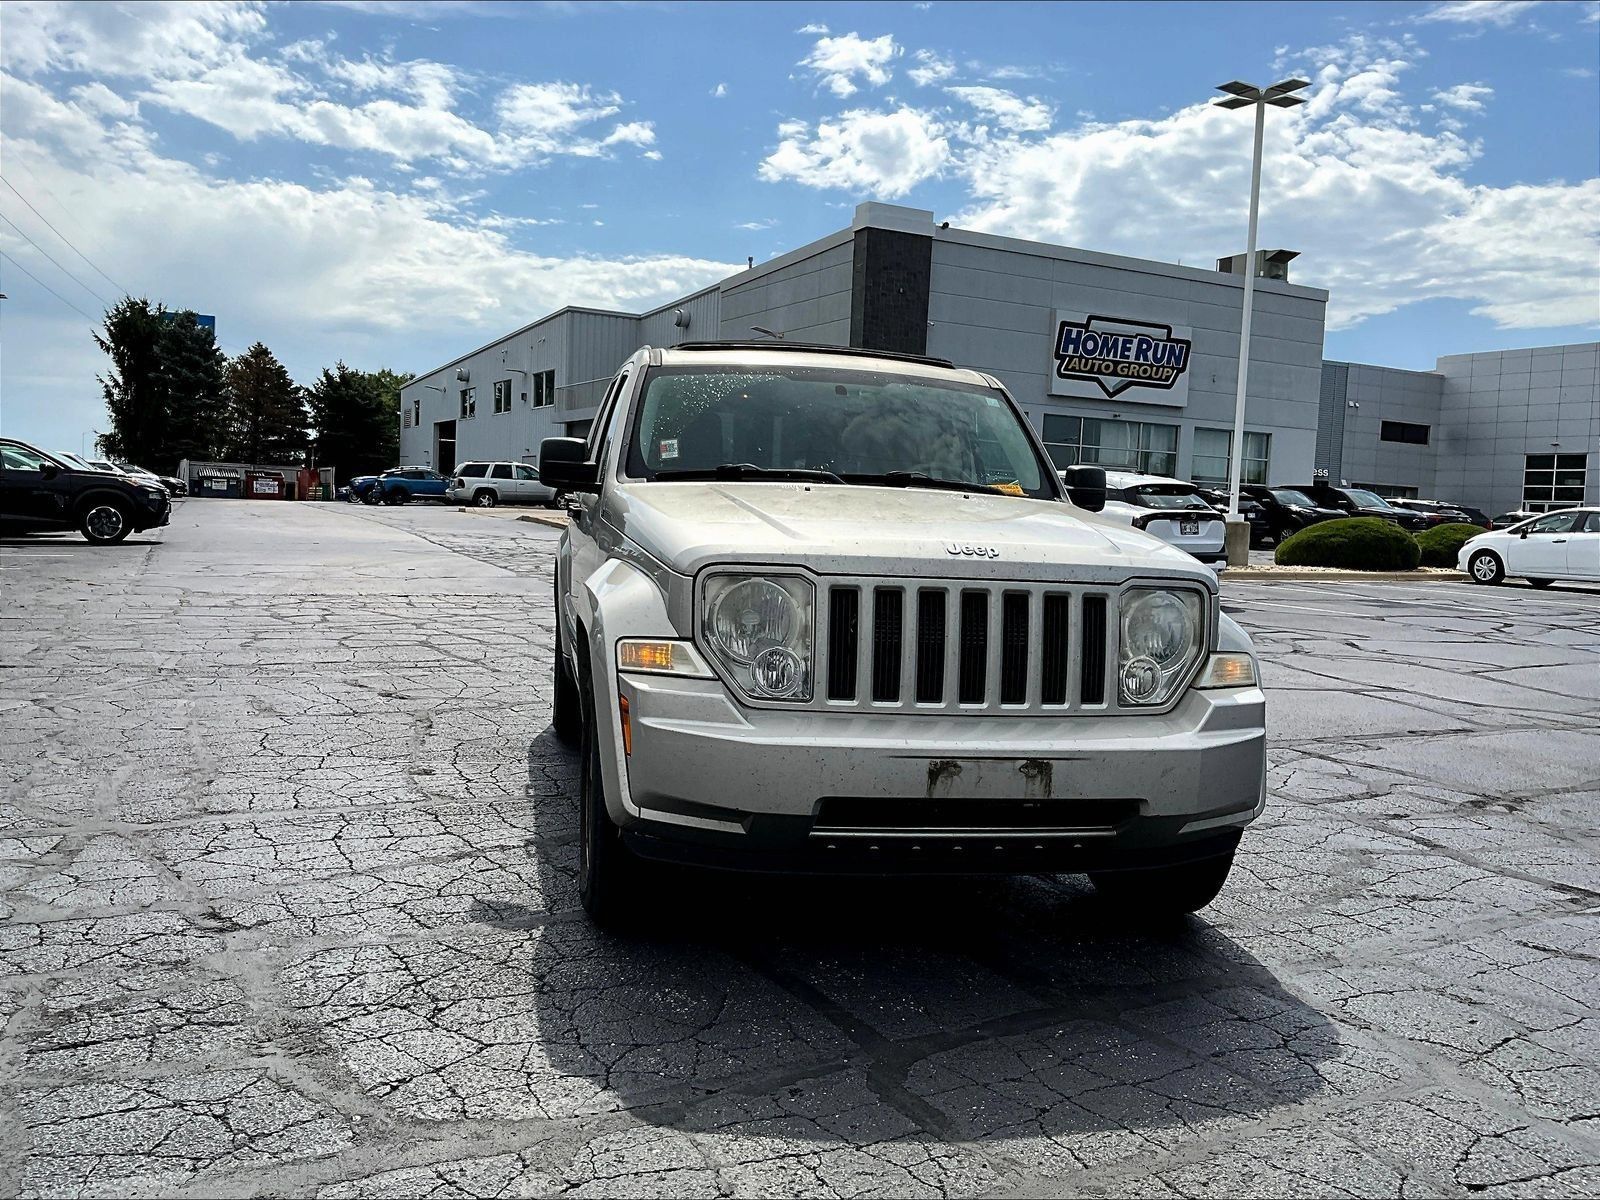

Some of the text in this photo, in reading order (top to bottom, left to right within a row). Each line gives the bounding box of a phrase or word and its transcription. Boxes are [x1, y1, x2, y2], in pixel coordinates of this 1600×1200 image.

[1068, 357, 1173, 380] AUTO GROUP
[946, 543, 1000, 559] Jeep
